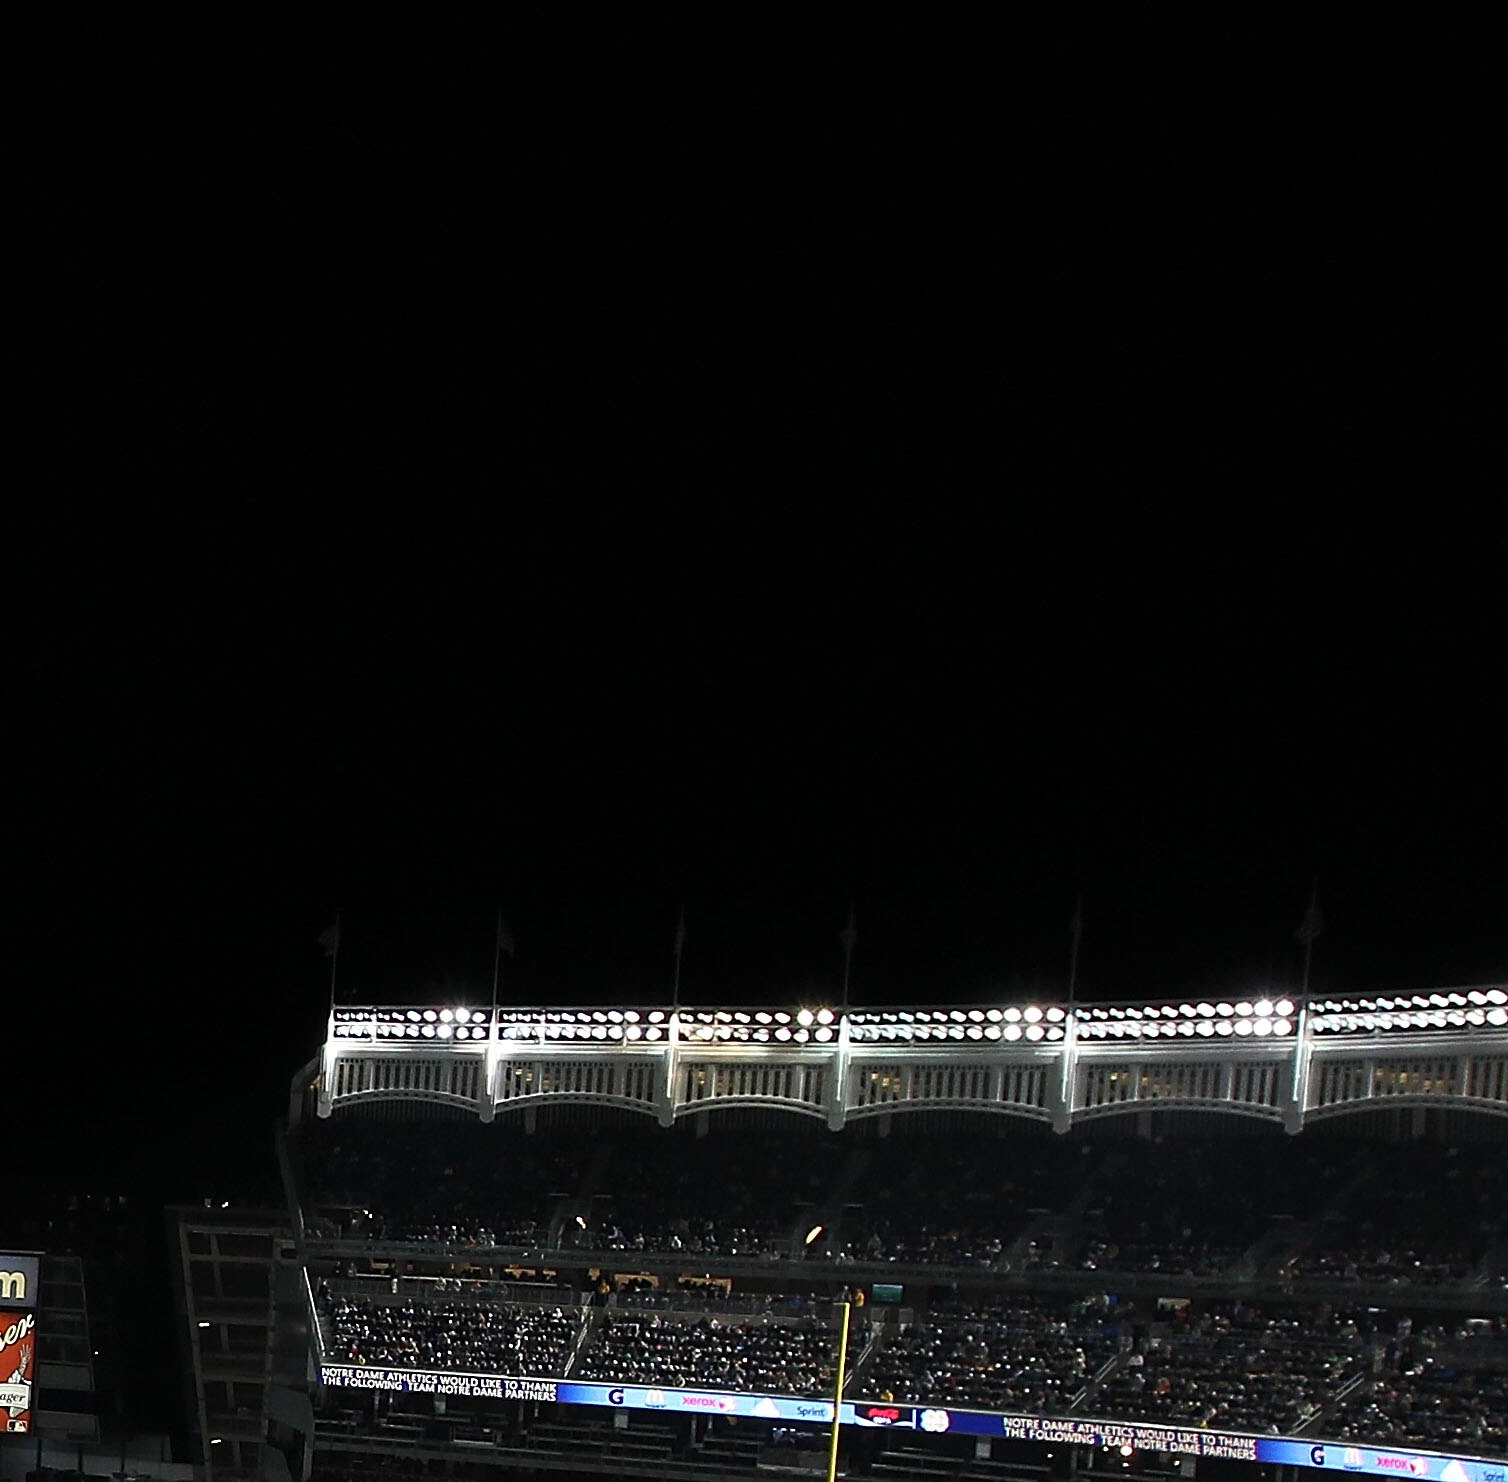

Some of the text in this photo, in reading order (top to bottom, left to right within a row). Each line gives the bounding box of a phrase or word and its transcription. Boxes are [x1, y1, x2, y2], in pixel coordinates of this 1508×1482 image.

[321, 1367, 557, 1393] NOTRE DAME ATHLETICS WOULD LIKE TO THANK
[322, 1376, 556, 1401] THE FOLLOWING TEAM NOTRE DAME PARTNERS
[608, 1388, 824, 1418] G xerox Sprint
[1004, 1417, 1256, 1448] NOTRE DAME ATHLETICS WOULD LIKE TO THANK
[1005, 1427, 1257, 1460] THE FOLLOWING TEAM NOTRE DAME PARTNERS
[1310, 1446, 1325, 1466] G
[1377, 1456, 1408, 1470] xerox
